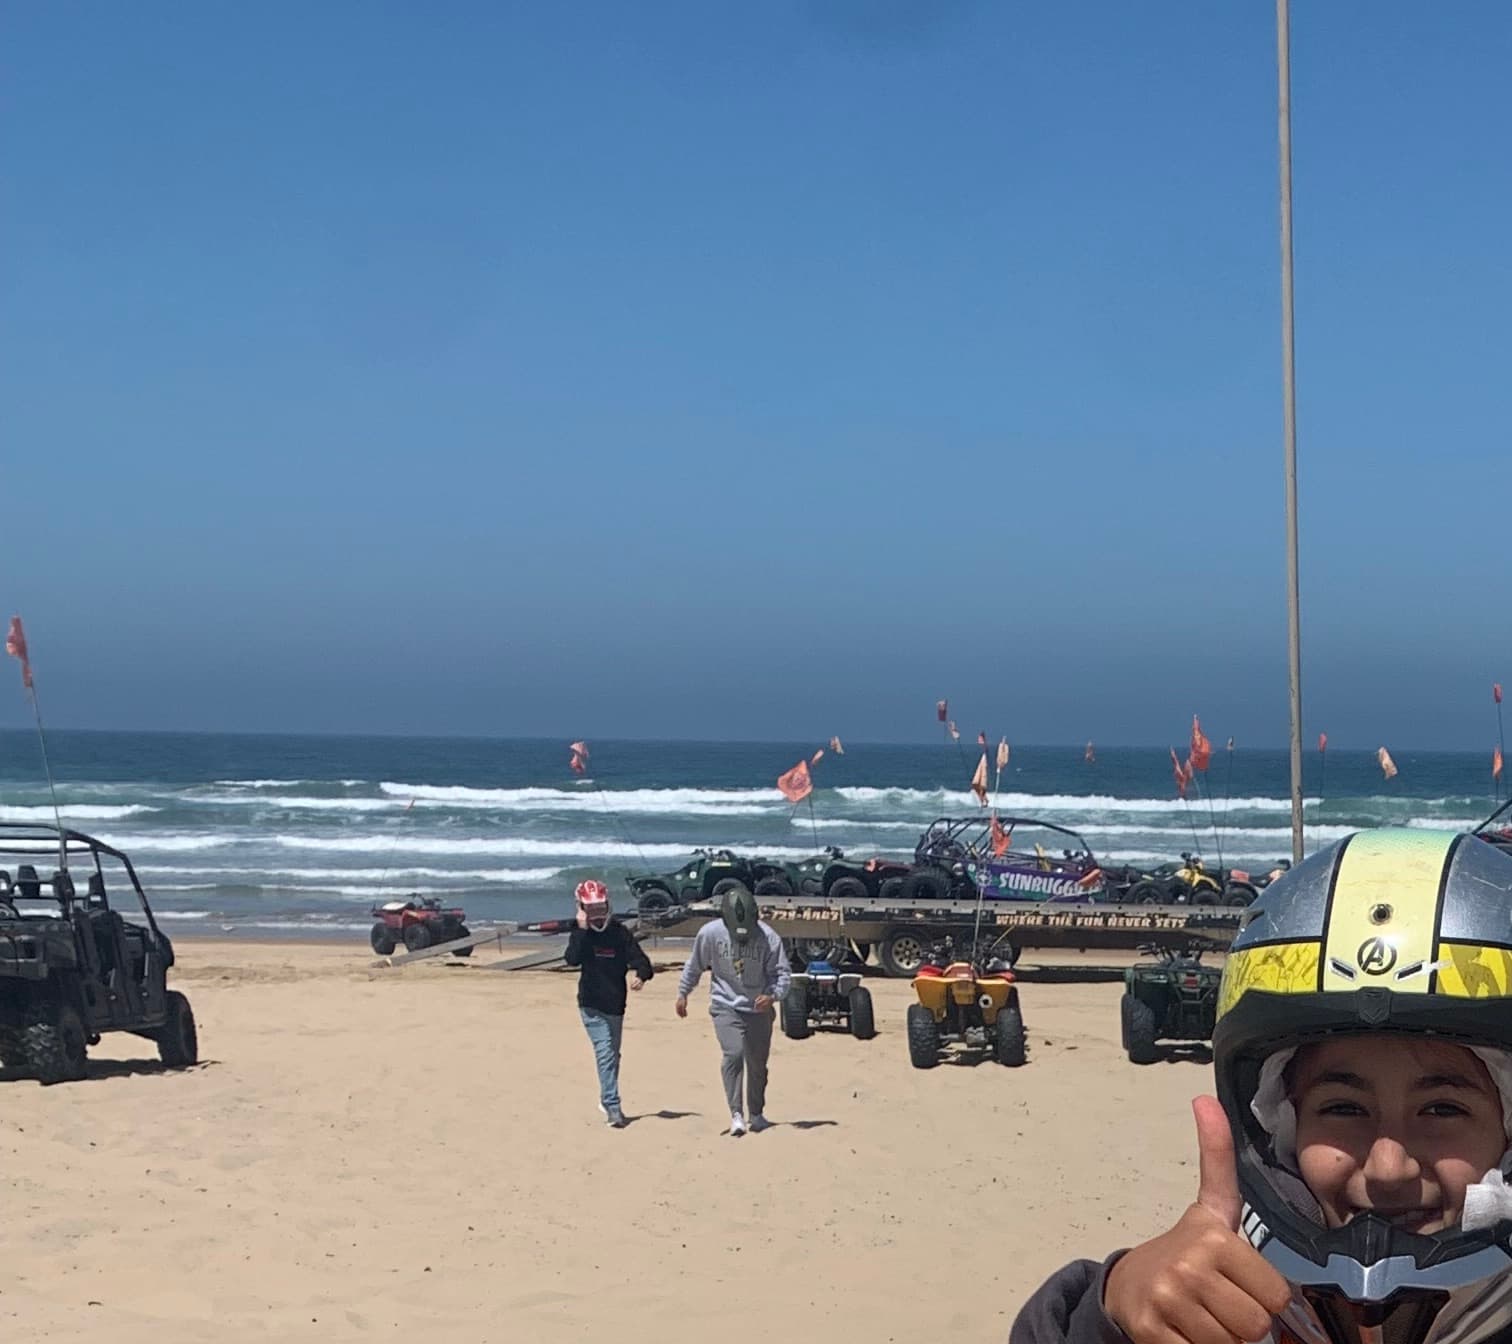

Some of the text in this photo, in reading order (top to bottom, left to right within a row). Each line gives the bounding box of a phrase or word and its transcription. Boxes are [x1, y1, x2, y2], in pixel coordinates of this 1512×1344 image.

[996, 914, 1186, 928] WHERE THE FUN NEVER SETS
